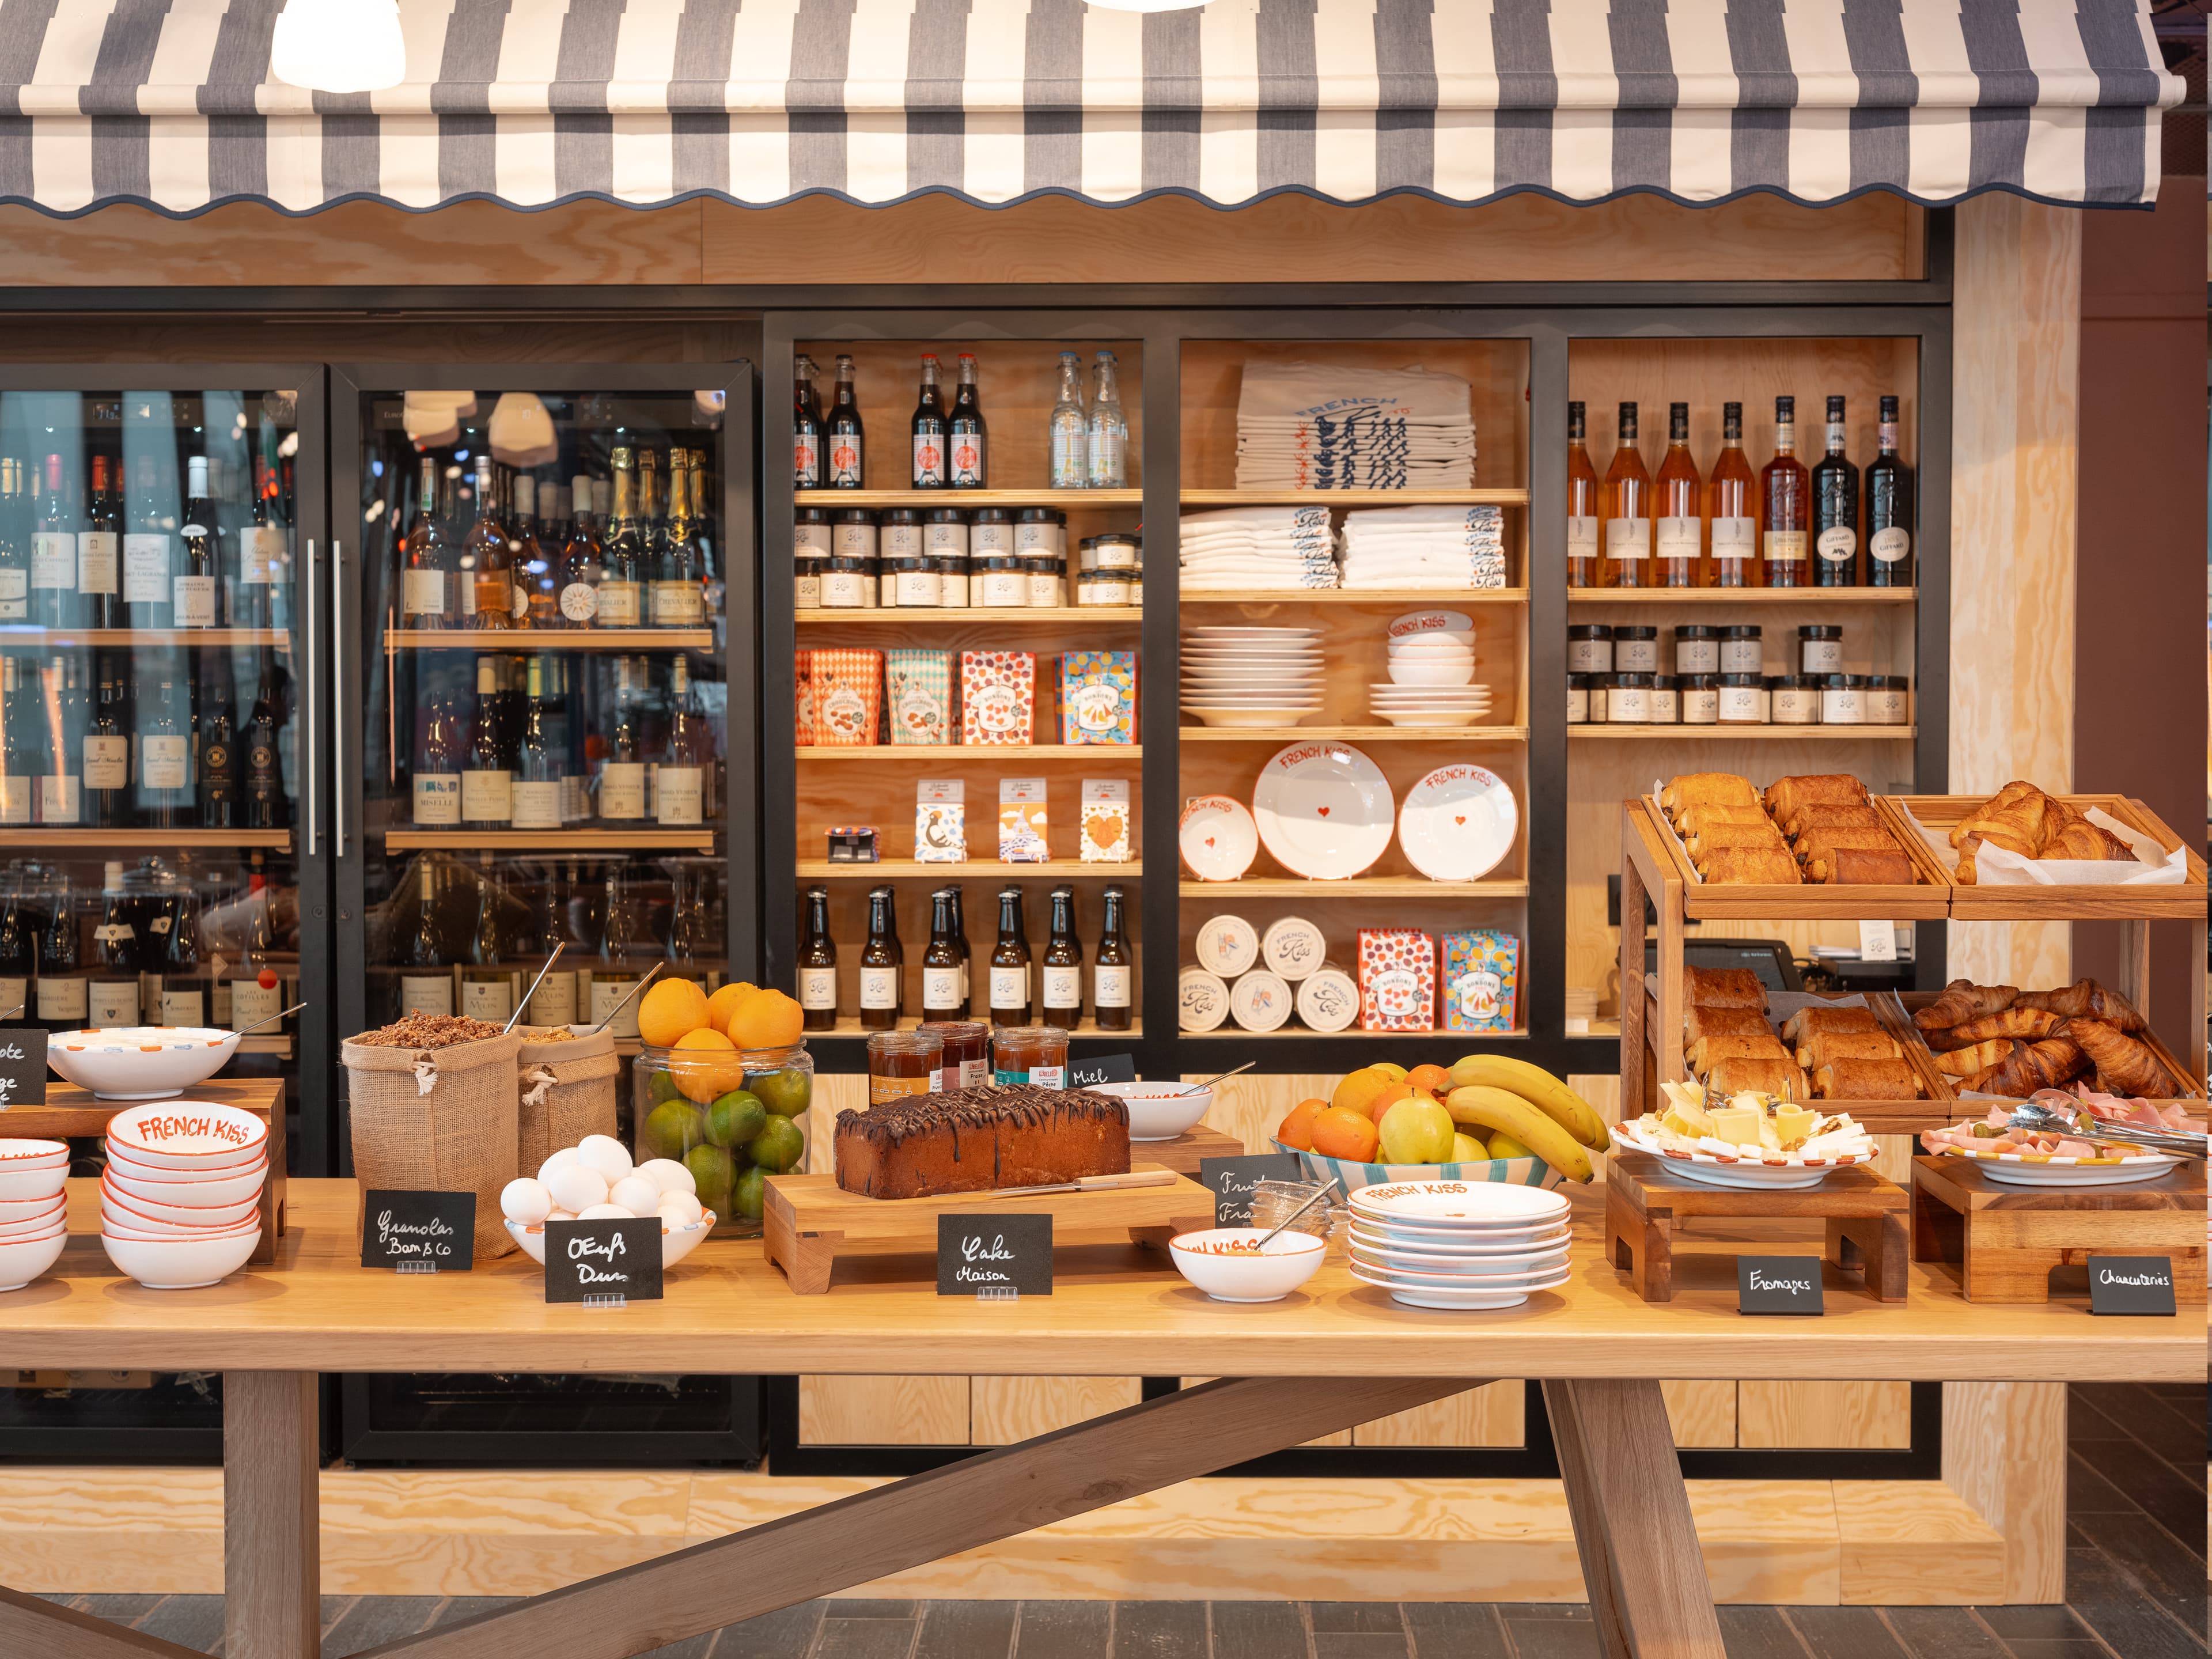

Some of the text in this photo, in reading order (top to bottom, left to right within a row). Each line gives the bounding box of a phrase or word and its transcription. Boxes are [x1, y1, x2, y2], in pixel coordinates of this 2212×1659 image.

[1294, 397, 1397, 416] FRENCH
[1826, 535, 1850, 543] GIFFARD
[1880, 543, 1904, 551] GIFFARD
[1422, 616, 1446, 629] KISS
[1279, 745, 1320, 769] FRENCH
[1426, 768, 1493, 789] FRENCH KISS
[1276, 932, 1309, 944] FRENCH
[1279, 938, 1312, 961] Kiss
[1183, 984, 1217, 995] FRENCH
[1383, 978, 1411, 986] BONBONS
[1467, 980, 1495, 989] BONBONS
[1182, 991, 1214, 1014] Kiss
[1313, 989, 1342, 1016] Kiss
[1323, 981, 1350, 1006] FRENCH
[1073, 1068, 1108, 1084] Miel
[138, 1116, 249, 1145] FRENCH KISS
[1365, 1184, 1468, 1201] FRENCH KISS
[378, 1210, 454, 1243] Granolas
[436, 1243, 451, 1255] Co
[961, 1234, 1016, 1262] Cake
[956, 1266, 1010, 1282] Maison
[1750, 1270, 1810, 1295] Fromages
